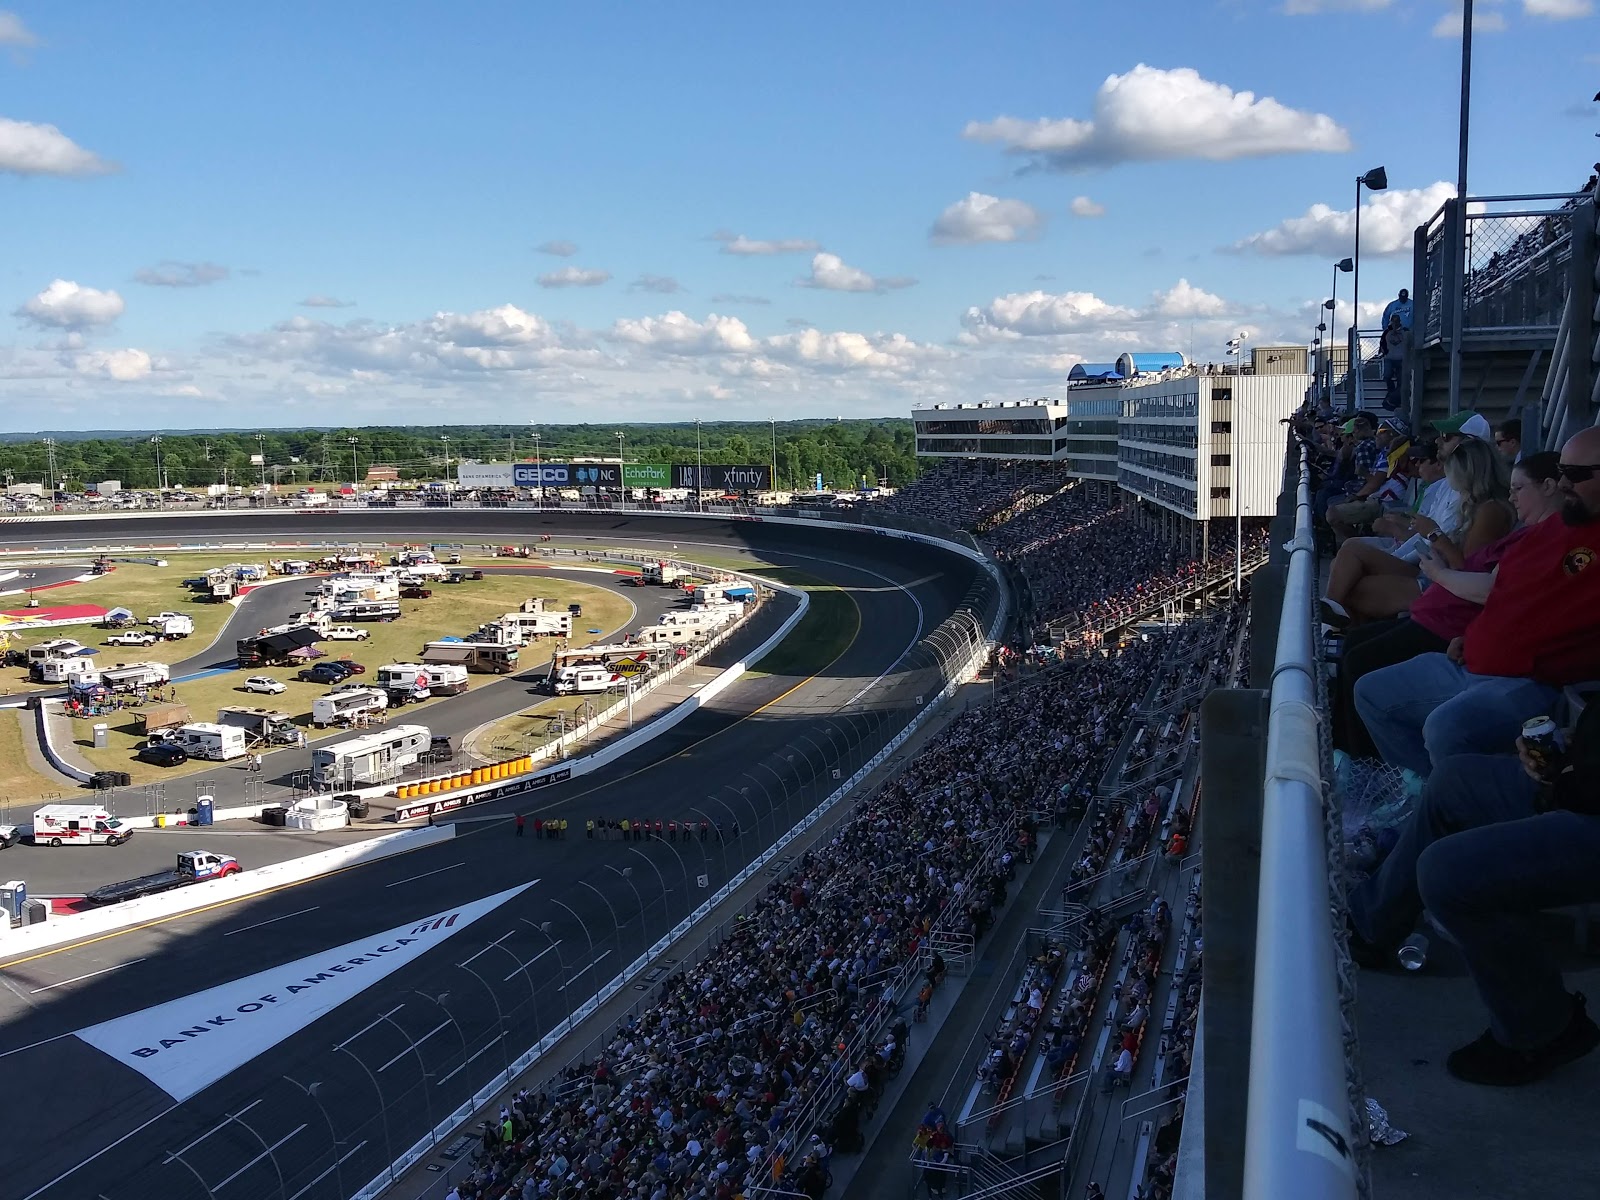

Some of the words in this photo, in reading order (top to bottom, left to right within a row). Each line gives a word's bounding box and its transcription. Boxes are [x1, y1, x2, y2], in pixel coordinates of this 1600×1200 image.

[515, 468, 568, 482] GEICO
[600, 469, 615, 481] NC
[625, 466, 666, 479] EchoPark
[679, 466, 693, 487] LAS
[723, 466, 763, 488] xfinity
[609, 664, 647, 672] SUNOCO
[130, 1014, 236, 1059] BANK
[236, 993, 280, 1014] OF
[285, 936, 419, 995] AMERICA
